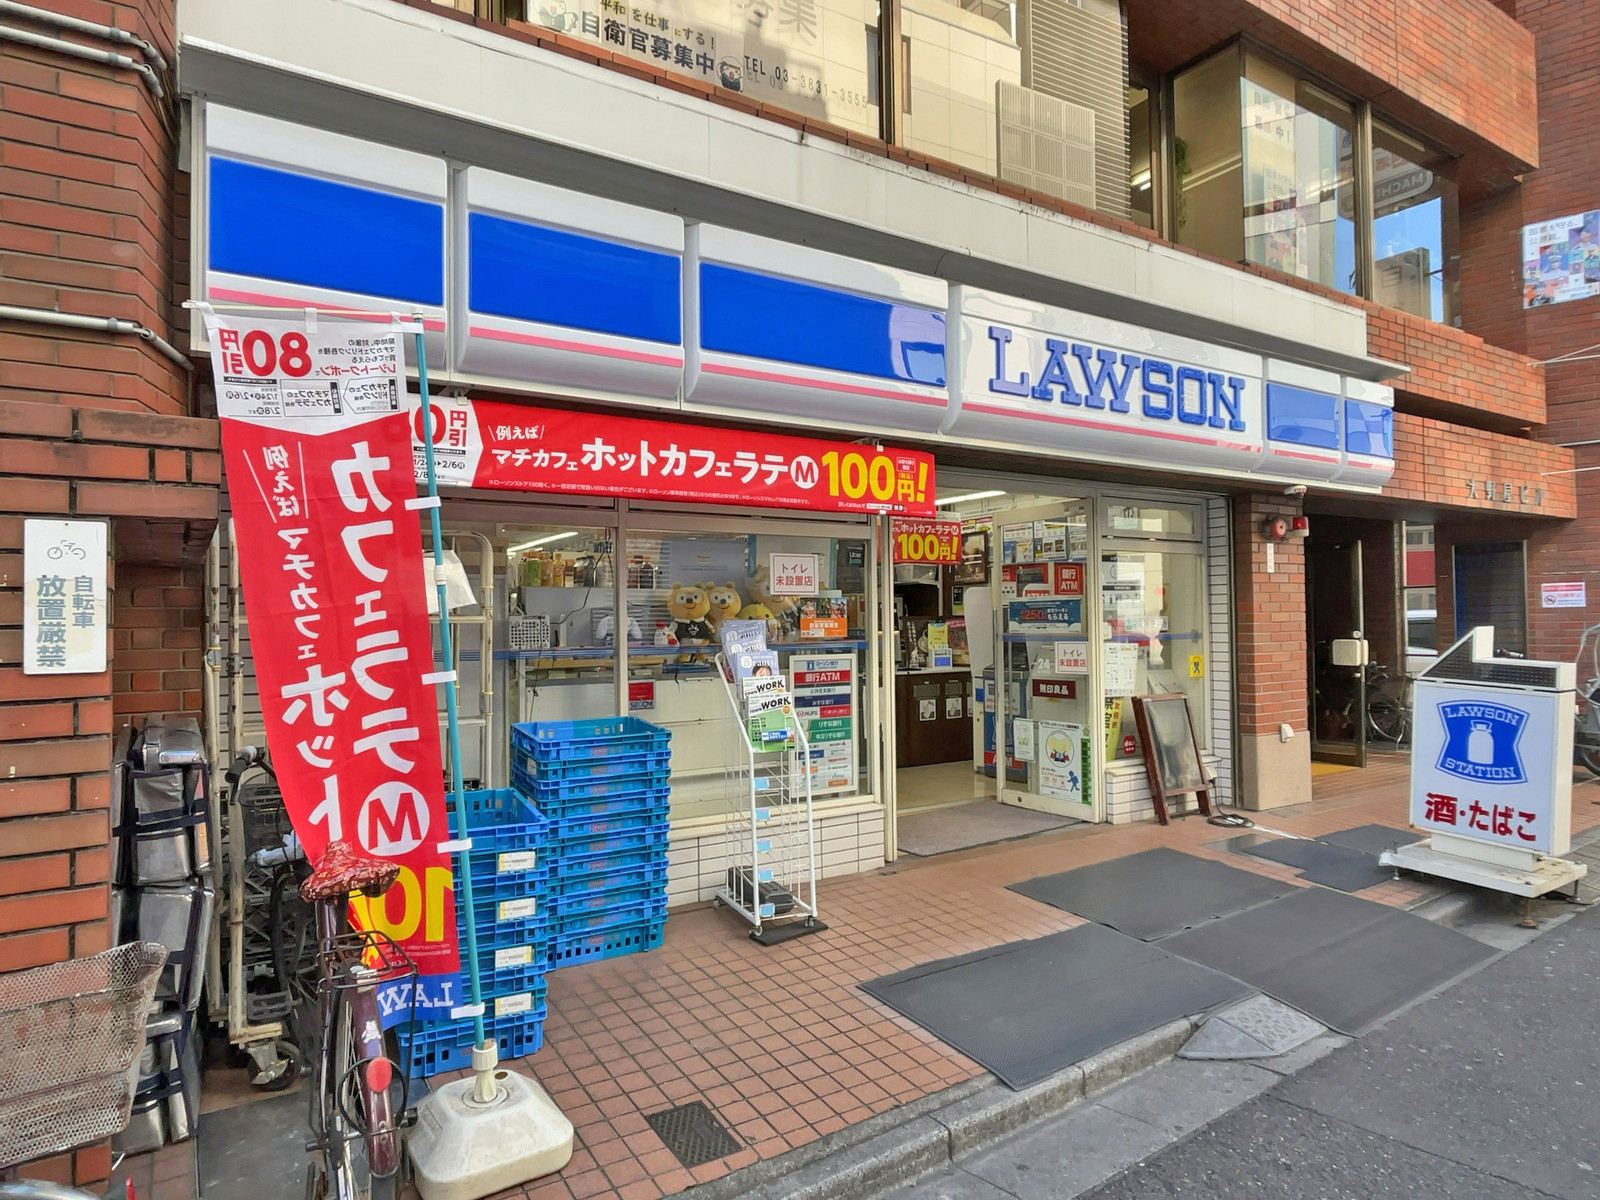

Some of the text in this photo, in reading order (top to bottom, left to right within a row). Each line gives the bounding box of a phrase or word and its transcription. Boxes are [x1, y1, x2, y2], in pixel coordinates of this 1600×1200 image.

[582, 10, 714, 75] 自衛官募集中
[744, 55, 766, 76] TEL
[988, 325, 1246, 431] LAWSON
[496, 424, 539, 441] 例えば
[782, 563, 808, 574] トイレ
[1062, 568, 1076, 579] 銀行
[776, 575, 813, 586] 未設置店
[1061, 581, 1078, 590] ATM
[72, 575, 95, 629] 自転車
[36, 574, 67, 668] 放置厳禁
[1063, 649, 1082, 657] トイレ
[1059, 658, 1087, 667] 未設置店
[805, 672, 840, 682] 銀行ATM
[756, 680, 785, 693] WORK
[1040, 683, 1069, 695] 無印良品
[761, 696, 791, 710] WORK
[1447, 704, 1520, 726] LAWSON
[1444, 758, 1517, 778] STATION
[1424, 792, 1537, 842] 酒・たばこ
